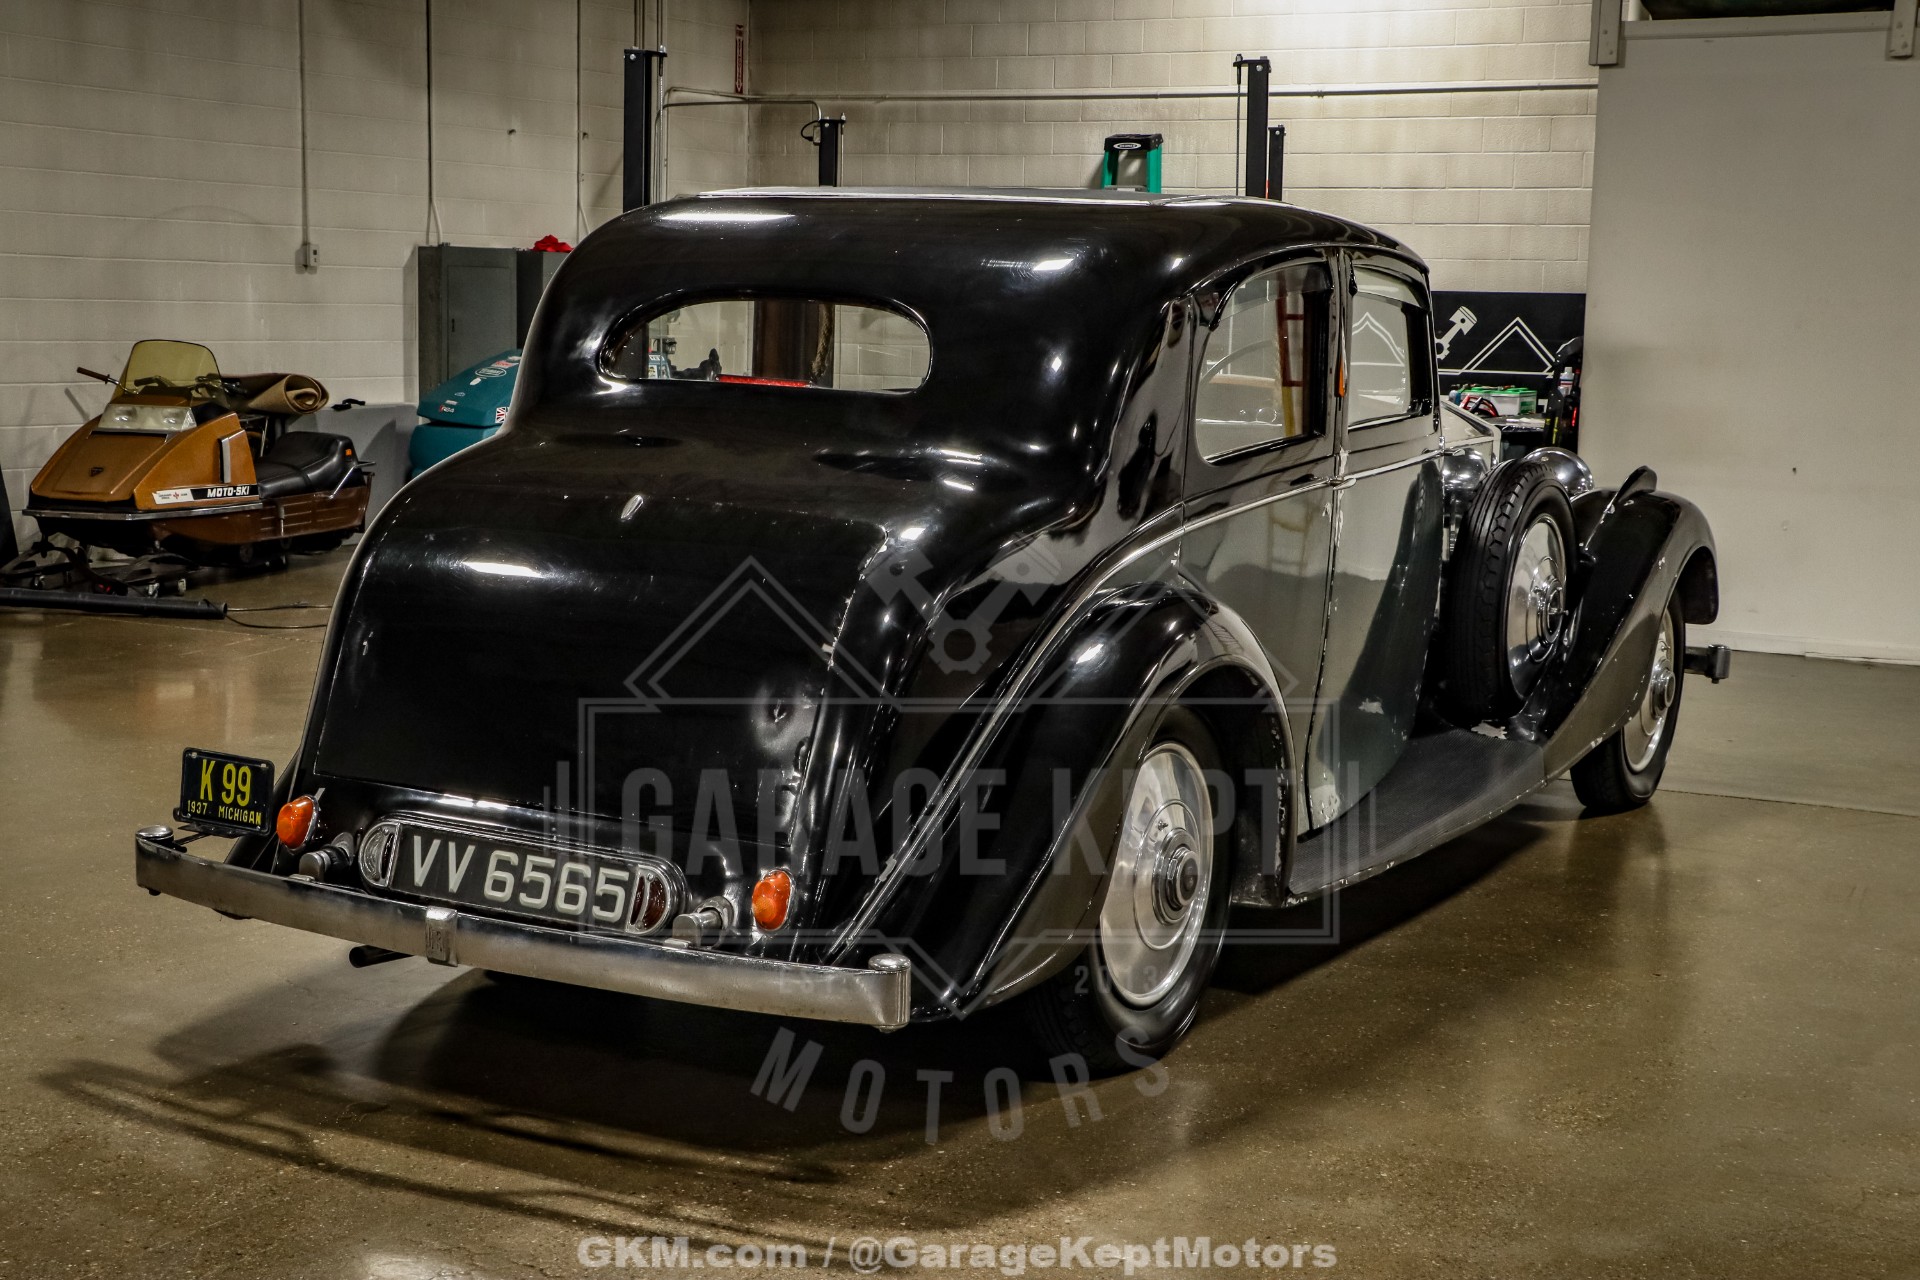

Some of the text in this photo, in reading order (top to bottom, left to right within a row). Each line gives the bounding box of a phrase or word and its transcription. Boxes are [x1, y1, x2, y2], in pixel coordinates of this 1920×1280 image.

[207, 486, 250, 498] MOTO-SKI
[200, 759, 251, 807] K 99
[187, 800, 262, 826] 1937 MICHIGAN
[413, 835, 630, 923] VV 6565
